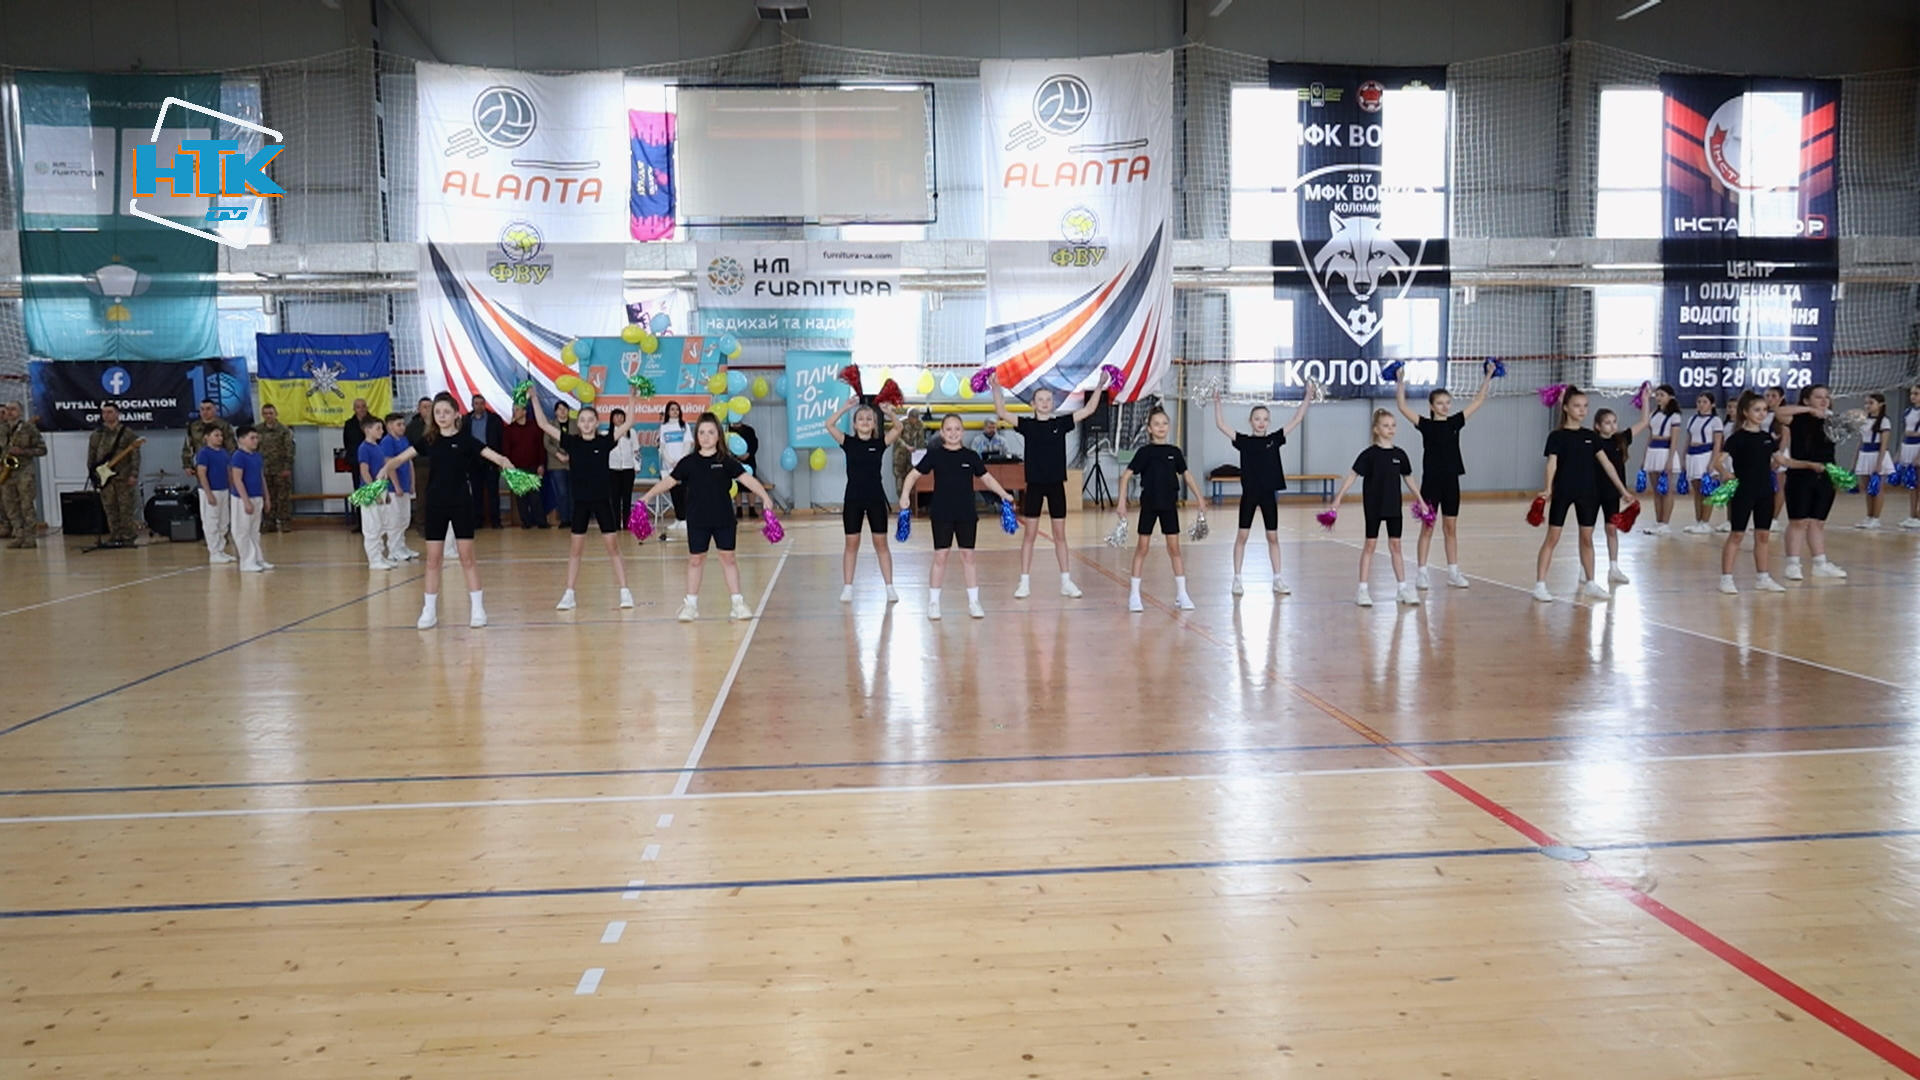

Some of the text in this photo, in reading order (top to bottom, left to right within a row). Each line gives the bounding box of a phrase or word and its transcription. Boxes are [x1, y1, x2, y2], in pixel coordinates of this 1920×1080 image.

[1003, 155, 1151, 188] ALANTA
[1347, 174, 1373, 184] 2017
[441, 170, 603, 204] ALANTA
[1304, 184, 1348, 201] МФК
[823, 250, 893, 260] furnitura-ua.com
[1051, 246, 1107, 267] ФВУ
[489, 262, 551, 285] ФВУ
[754, 258, 790, 273] HM
[1727, 260, 1775, 279] ЦЕНТР
[754, 280, 893, 297] FURNITURA
[1700, 281, 1802, 301] ОПАЛЕННЯ ТА
[706, 314, 779, 332] надихай
[784, 320, 801, 330] та
[796, 362, 839, 388] ПЛІЧ
[1679, 367, 1812, 389] 095 28 103 28
[55, 398, 177, 410] FUTSAL ASOCIATION
[682, 403, 706, 414] АЙОН
[796, 397, 840, 422] ПЛІЧ
[86, 413, 153, 423] OF RAINE
